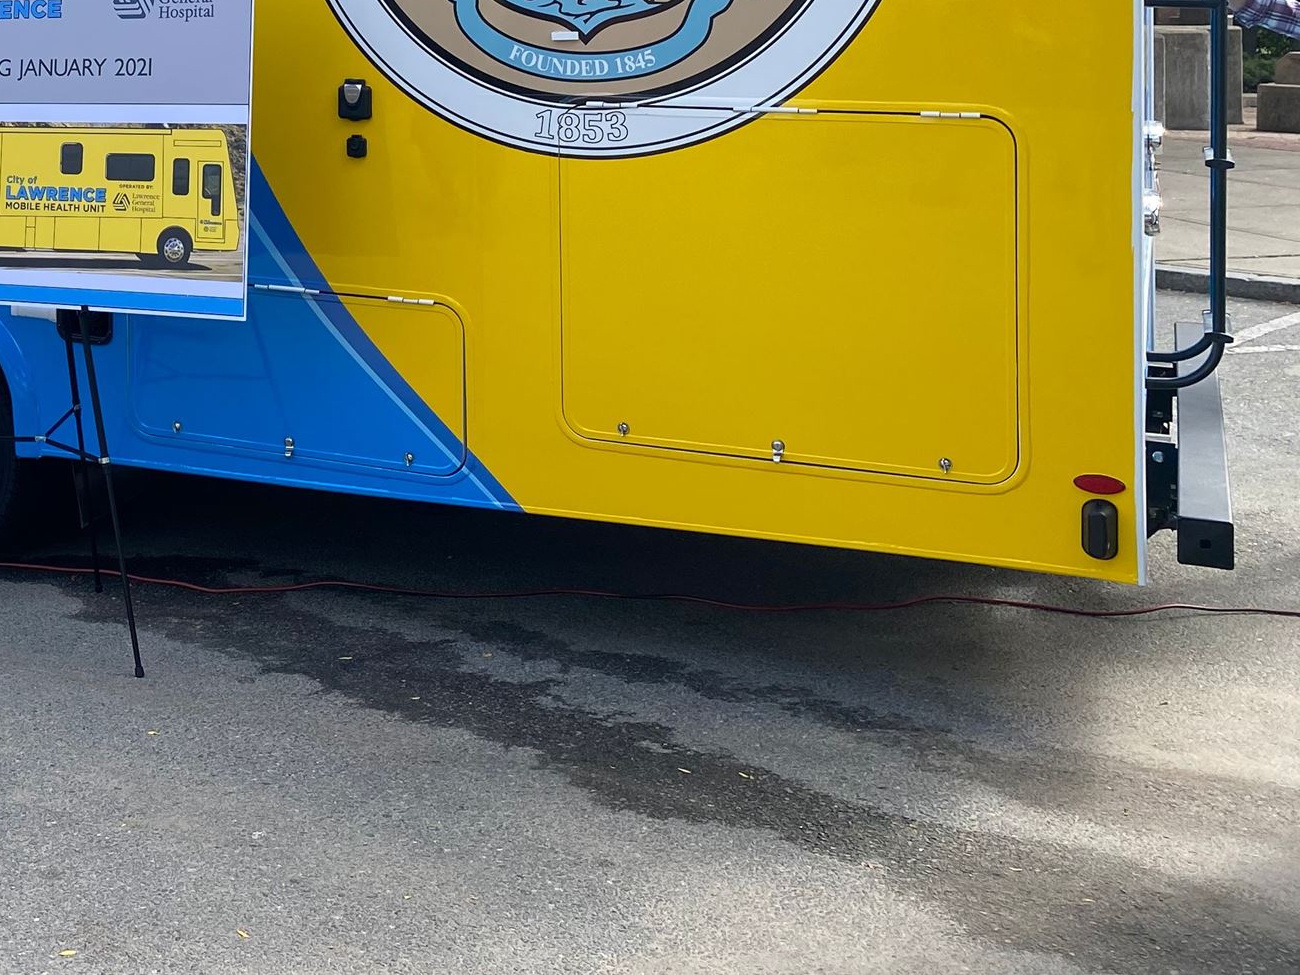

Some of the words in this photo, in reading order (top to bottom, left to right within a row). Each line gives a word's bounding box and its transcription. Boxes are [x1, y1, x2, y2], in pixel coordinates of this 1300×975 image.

[158, 5, 215, 22] Hospital
[17, 58, 107, 81] JANUARY
[114, 57, 152, 77] 2021
[508, 44, 609, 76] FOUNDED
[614, 49, 656, 74] 1845
[534, 109, 629, 144] 1853
[6, 175, 25, 185] City
[27, 175, 38, 184] of
[5, 185, 107, 203] LAWRENCE
[5, 202, 41, 211] MOBILE
[43, 203, 80, 212] HEALTH
[83, 204, 107, 213] UNIT
